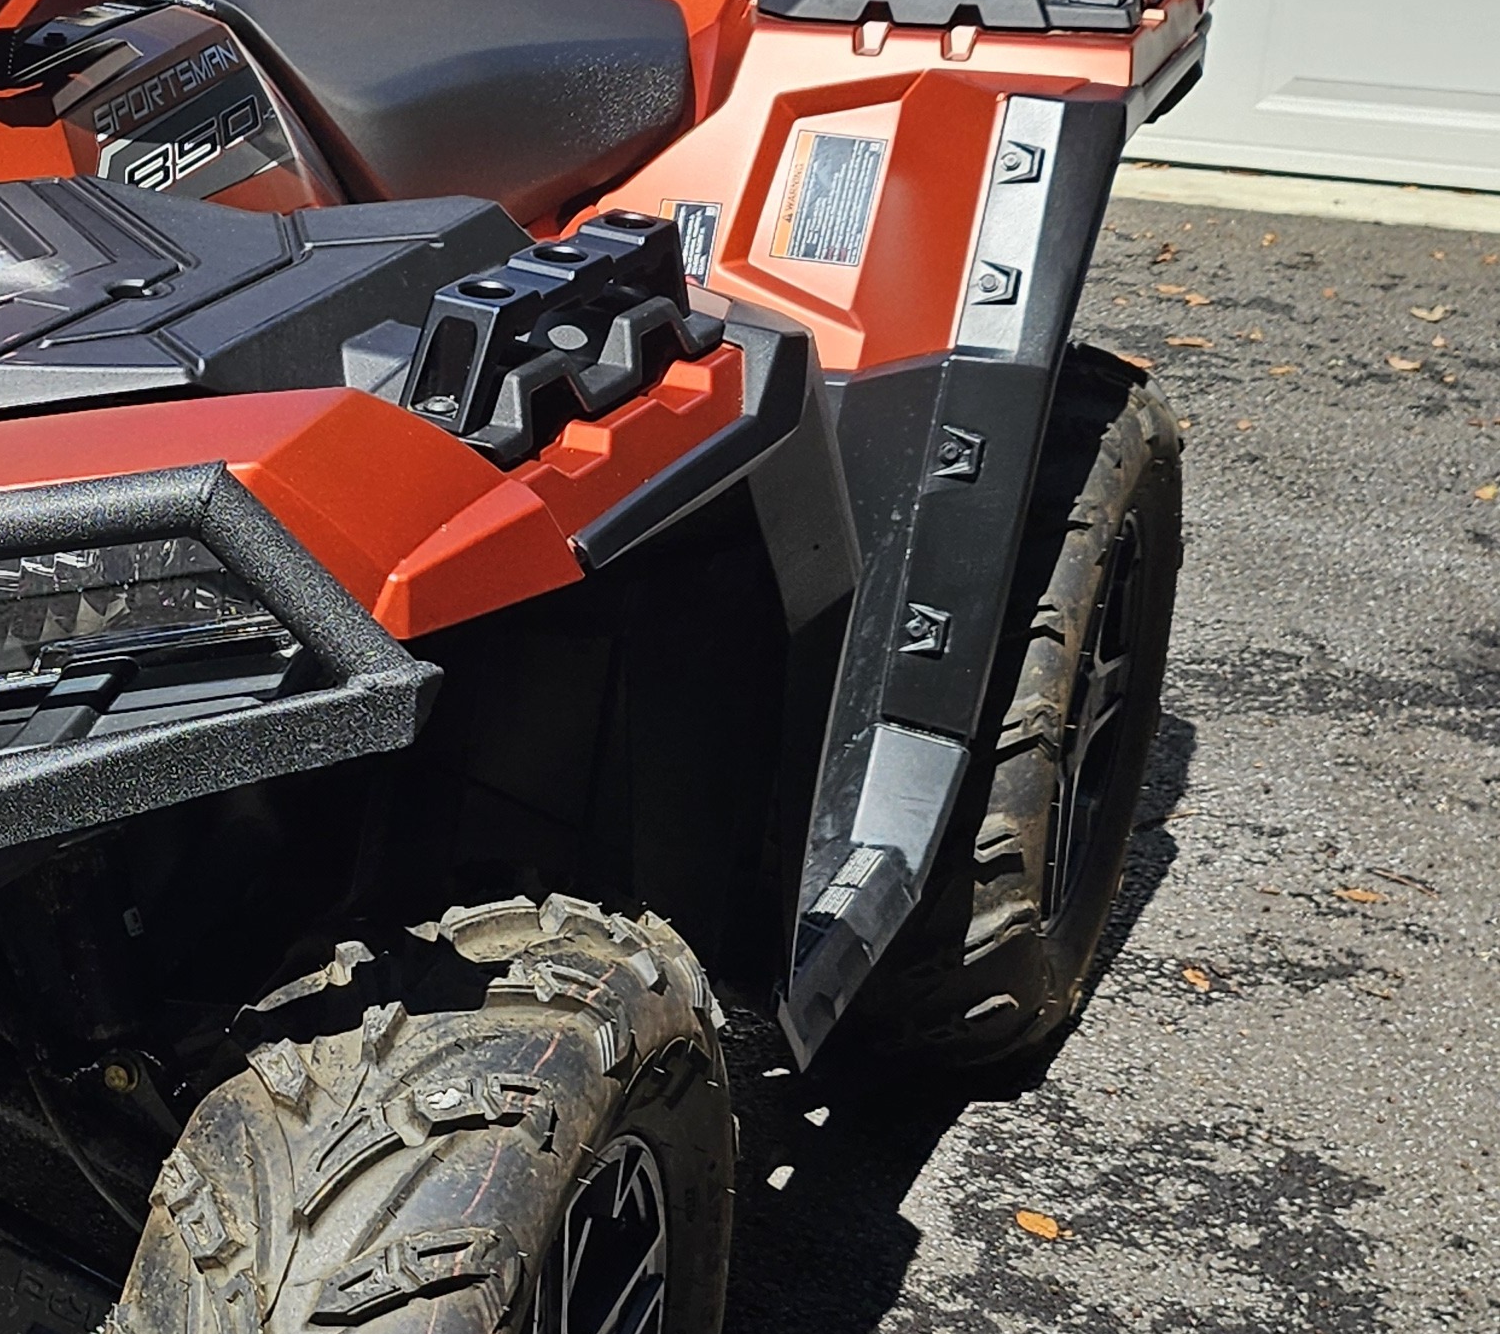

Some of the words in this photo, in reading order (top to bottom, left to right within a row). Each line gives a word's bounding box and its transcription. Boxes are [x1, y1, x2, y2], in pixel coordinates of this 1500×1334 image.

[93, 37, 240, 135] SPORTSMAN
[125, 94, 263, 192] 850
[786, 163, 804, 212] WARNING
